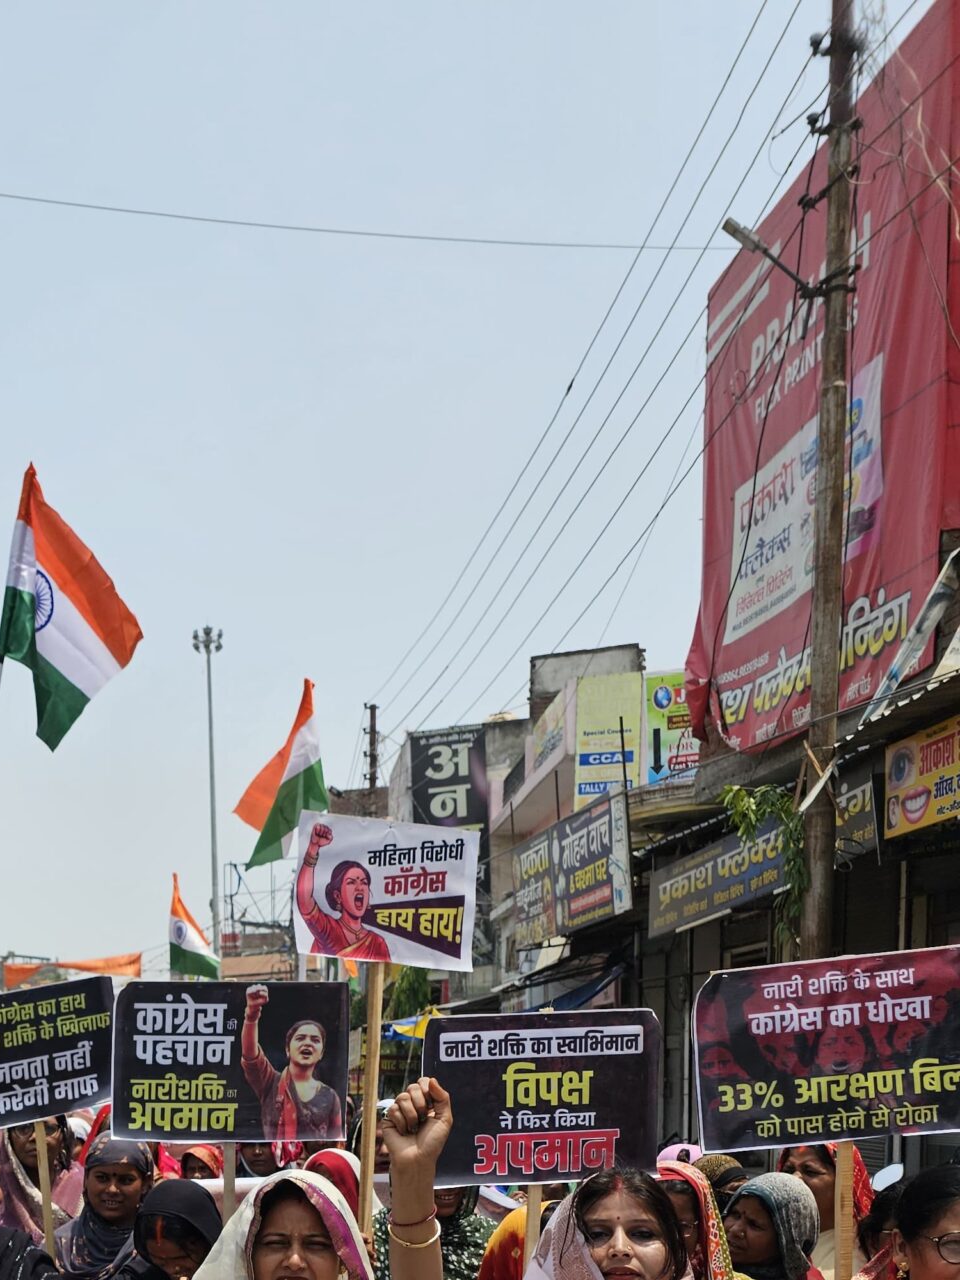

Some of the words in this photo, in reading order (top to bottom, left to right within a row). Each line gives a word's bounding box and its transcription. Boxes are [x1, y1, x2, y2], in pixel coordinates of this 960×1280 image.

[748, 211, 871, 392] PRAKH
[589, 753, 623, 764] CCA
[581, 783, 604, 793] TALLY
[367, 844, 417, 867] महिला
[420, 838, 465, 863] विरोधी
[561, 824, 588, 869] मोहन
[589, 814, 611, 854] वाच
[520, 840, 549, 880] एकता
[658, 860, 714, 911] प्रकाश
[374, 908, 415, 932] हाय
[417, 906, 464, 944] हाय!
[761, 974, 804, 1000] नारी
[808, 971, 848, 995] शक्ति
[851, 968, 870, 990] के
[874, 967, 915, 988] साथ
[37, 998, 56, 1017] का
[58, 993, 86, 1012] हाथ
[134, 993, 228, 1034] कांग्रेस
[226, 1018, 238, 1031] की
[748, 1002, 825, 1036] कांग्रेस
[827, 1003, 861, 1027] का
[865, 993, 932, 1023] धोखा
[3, 1023, 37, 1048] शक्ति
[39, 1019, 55, 1040] के
[56, 1011, 111, 1038] खिलाफ
[443, 1034, 483, 1059] नारी
[487, 1032, 527, 1057] शक्ति
[529, 1036, 553, 1055] का
[555, 1029, 640, 1054] स्वाभिमान
[52, 1040, 93, 1072] नहीं
[133, 1034, 235, 1066] पहचान
[52, 1073, 99, 1100] माफ
[226, 1088, 238, 1099] का
[502, 1061, 594, 1108] विपक्ष
[718, 1080, 784, 1113] 33%
[794, 1068, 906, 1105] आरक्षण
[128, 1101, 238, 1132] अपमान
[499, 1110, 515, 1130] ने
[516, 1110, 551, 1130] फिर
[552, 1108, 597, 1128] किया
[755, 1114, 782, 1138] को
[785, 1115, 824, 1136] पास
[827, 1106, 867, 1133] होने
[870, 1104, 891, 1128] से
[893, 1102, 939, 1126] रोका
[473, 1128, 620, 1175] अपमान
